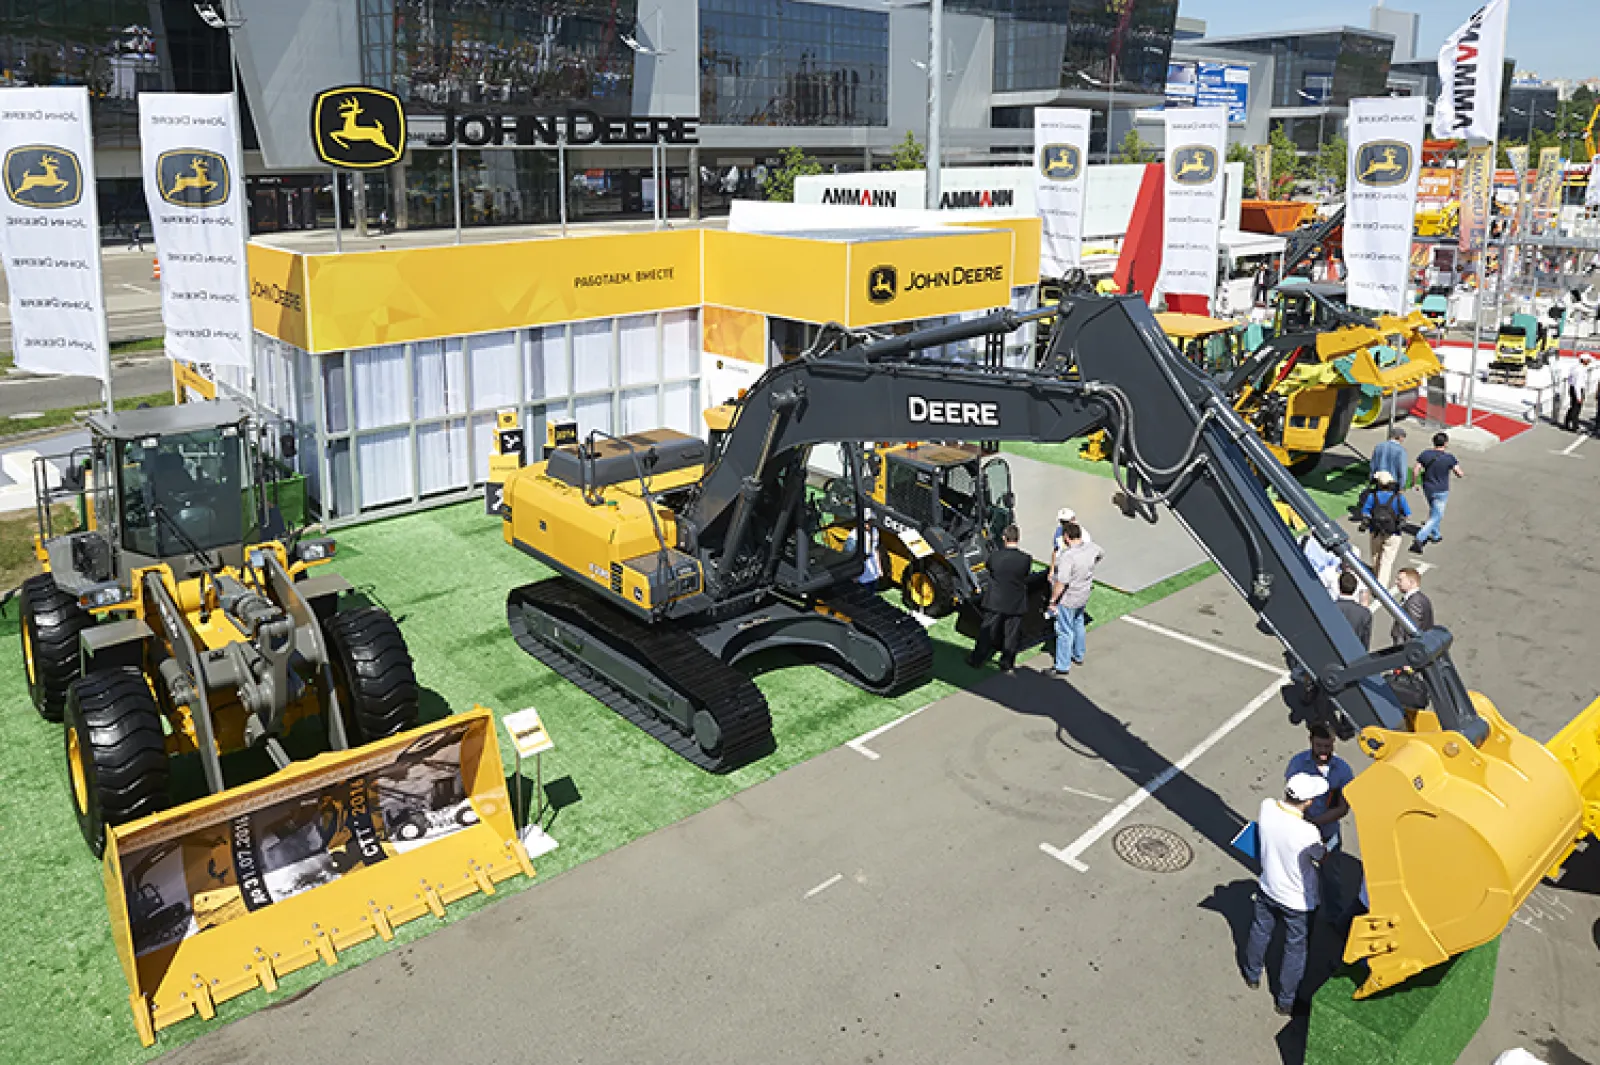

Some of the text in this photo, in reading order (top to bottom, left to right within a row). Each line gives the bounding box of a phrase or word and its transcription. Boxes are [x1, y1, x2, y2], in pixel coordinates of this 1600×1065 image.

[426, 108, 700, 146] JOHN DEERE
[821, 188, 897, 208] AMMANN
[940, 190, 1014, 210] AMMANN
[905, 265, 1004, 292] JOHN DEERE
[908, 396, 999, 427] DEERE
